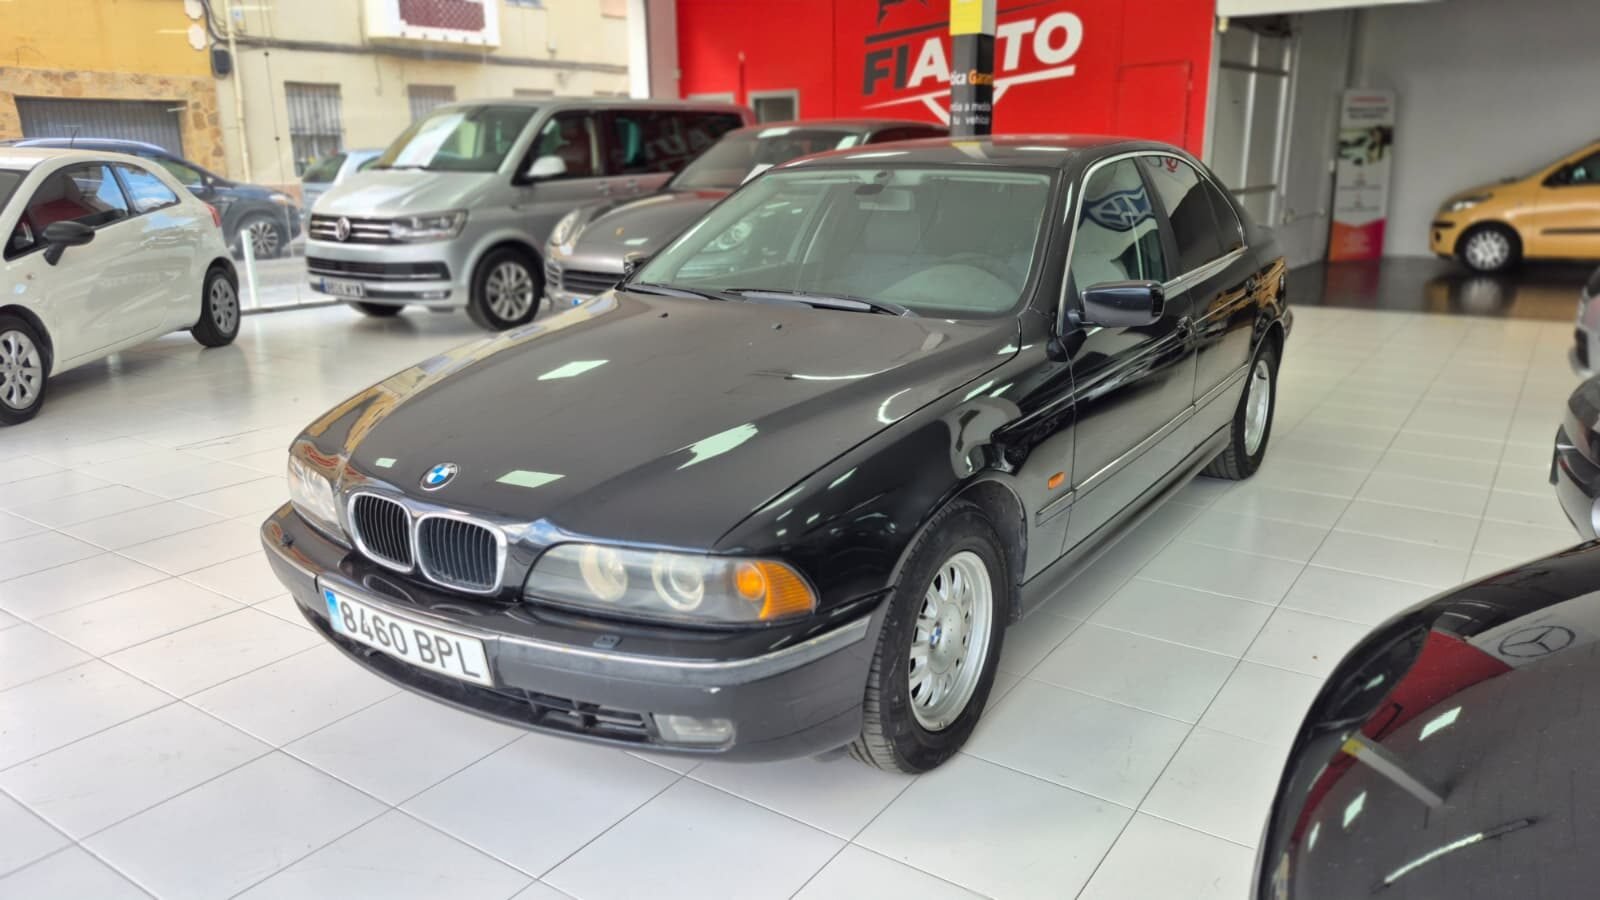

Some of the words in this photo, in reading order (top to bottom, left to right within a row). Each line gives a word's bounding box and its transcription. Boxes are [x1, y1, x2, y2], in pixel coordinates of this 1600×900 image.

[863, 11, 1084, 95] FIATO
[340, 601, 408, 656] 8460
[413, 628, 481, 679] BPL
